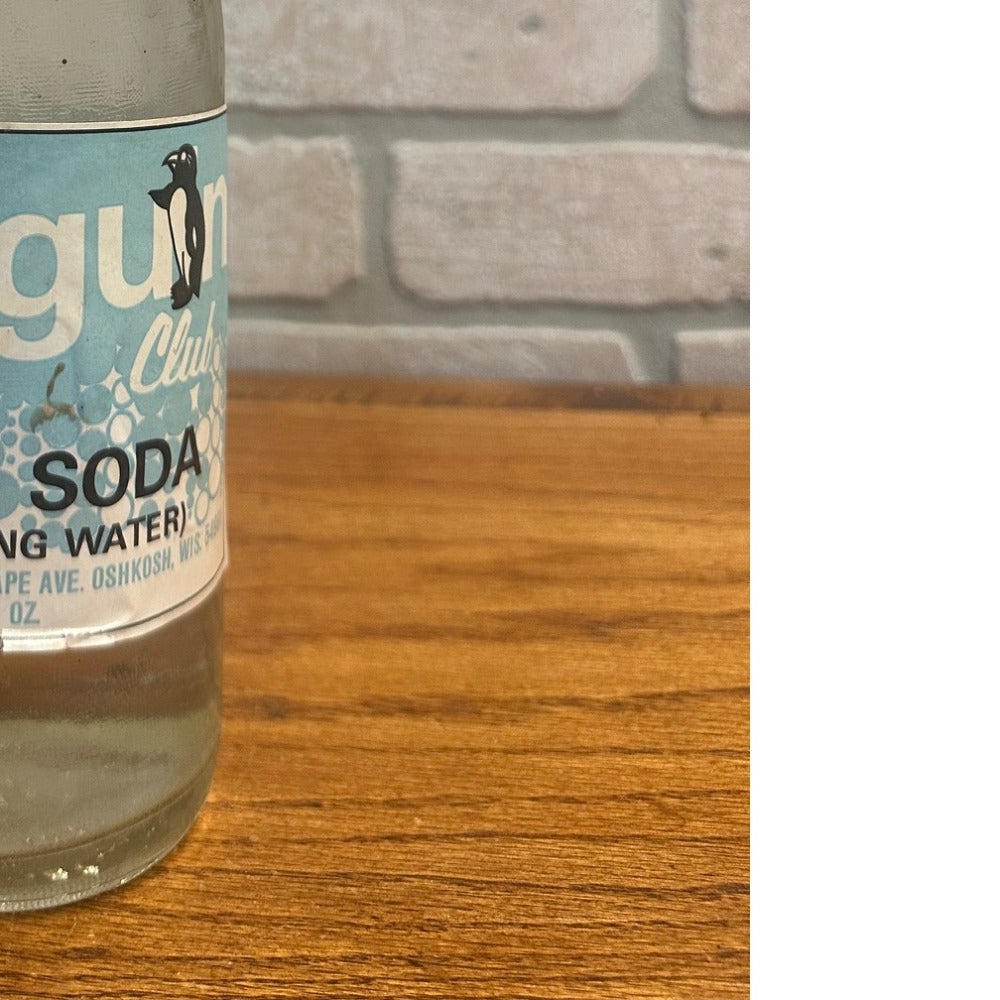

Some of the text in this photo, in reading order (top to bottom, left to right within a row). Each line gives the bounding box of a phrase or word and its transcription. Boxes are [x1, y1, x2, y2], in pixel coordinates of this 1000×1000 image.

[29, 424, 202, 512] SODA
[64, 500, 186, 558] WATER)
[39, 570, 84, 594] AVE.
[92, 547, 175, 590] OSHKOSH,
